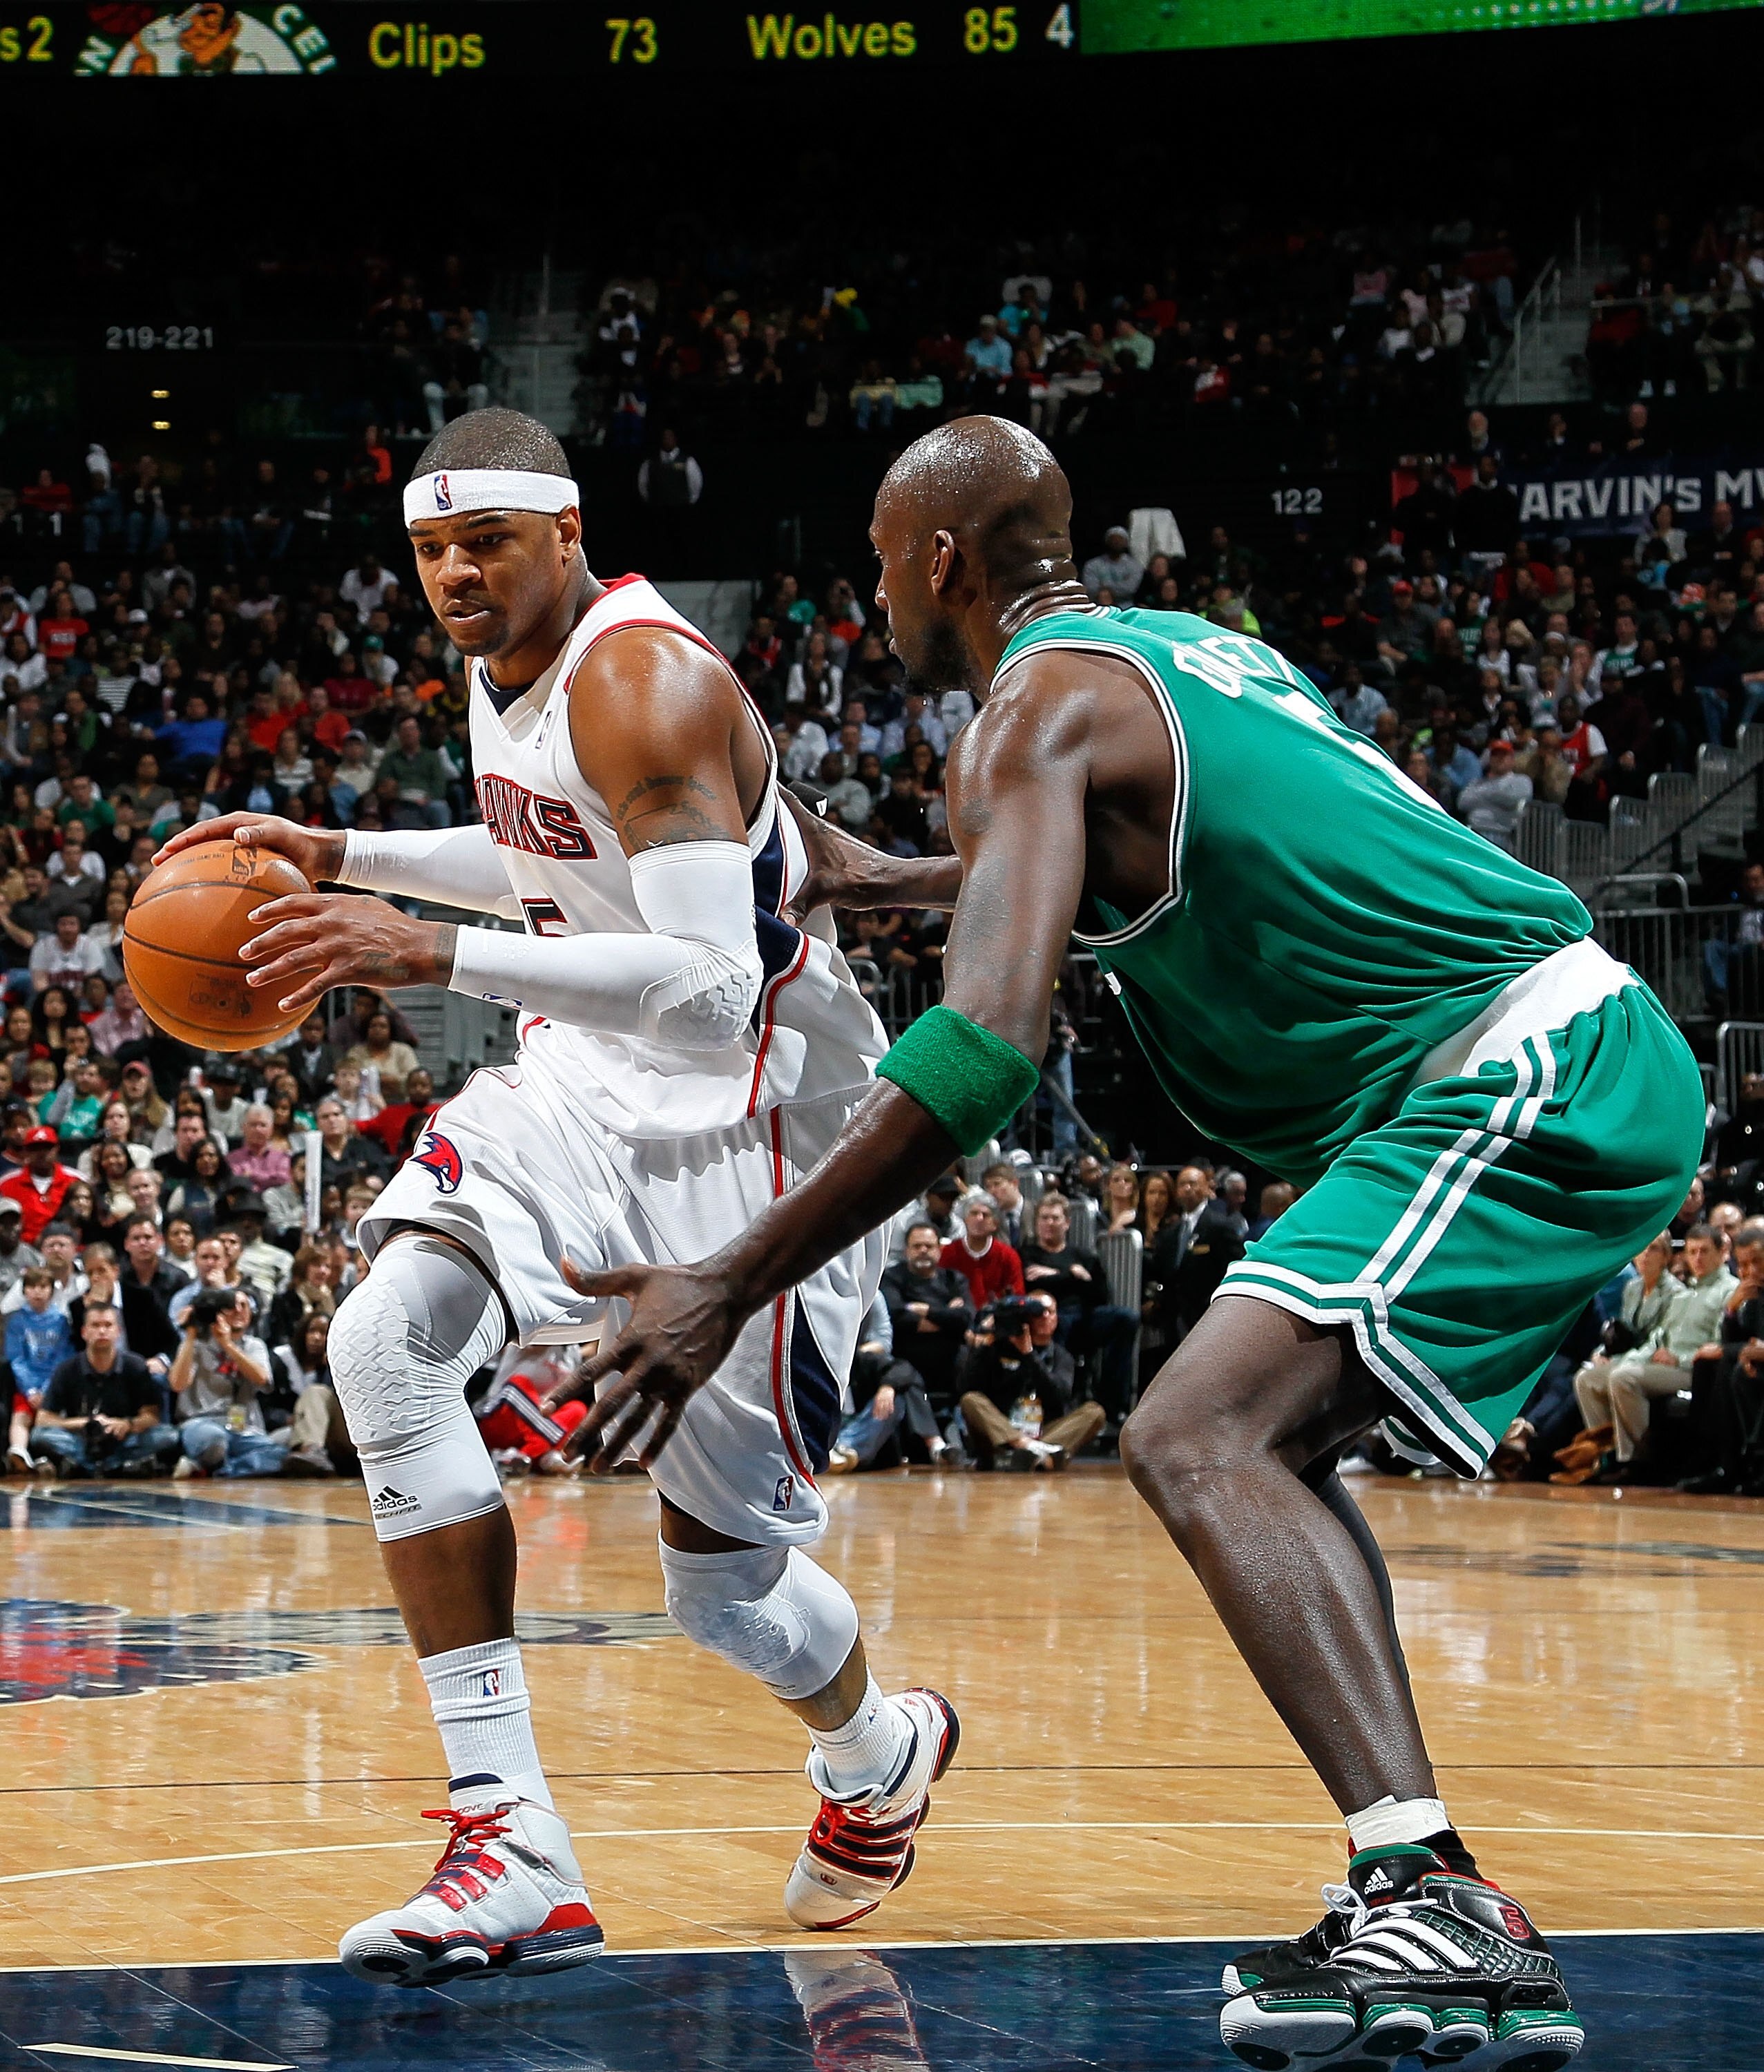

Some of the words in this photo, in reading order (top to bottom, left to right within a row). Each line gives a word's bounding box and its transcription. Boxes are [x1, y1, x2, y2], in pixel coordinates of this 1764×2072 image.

[747, 12, 918, 60] Wolves
[964, 6, 1017, 55] 85
[1045, 3, 1075, 50] 4
[369, 22, 486, 77] Clips
[605, 17, 657, 64] 73
[106, 326, 213, 350] 219-221
[1271, 488, 1323, 515] 122
[1508, 474, 1701, 522] ARVIN'S
[1715, 469, 1764, 509] M
[372, 1495, 418, 1511] adidas
[1364, 1880, 1394, 1895] adidas
